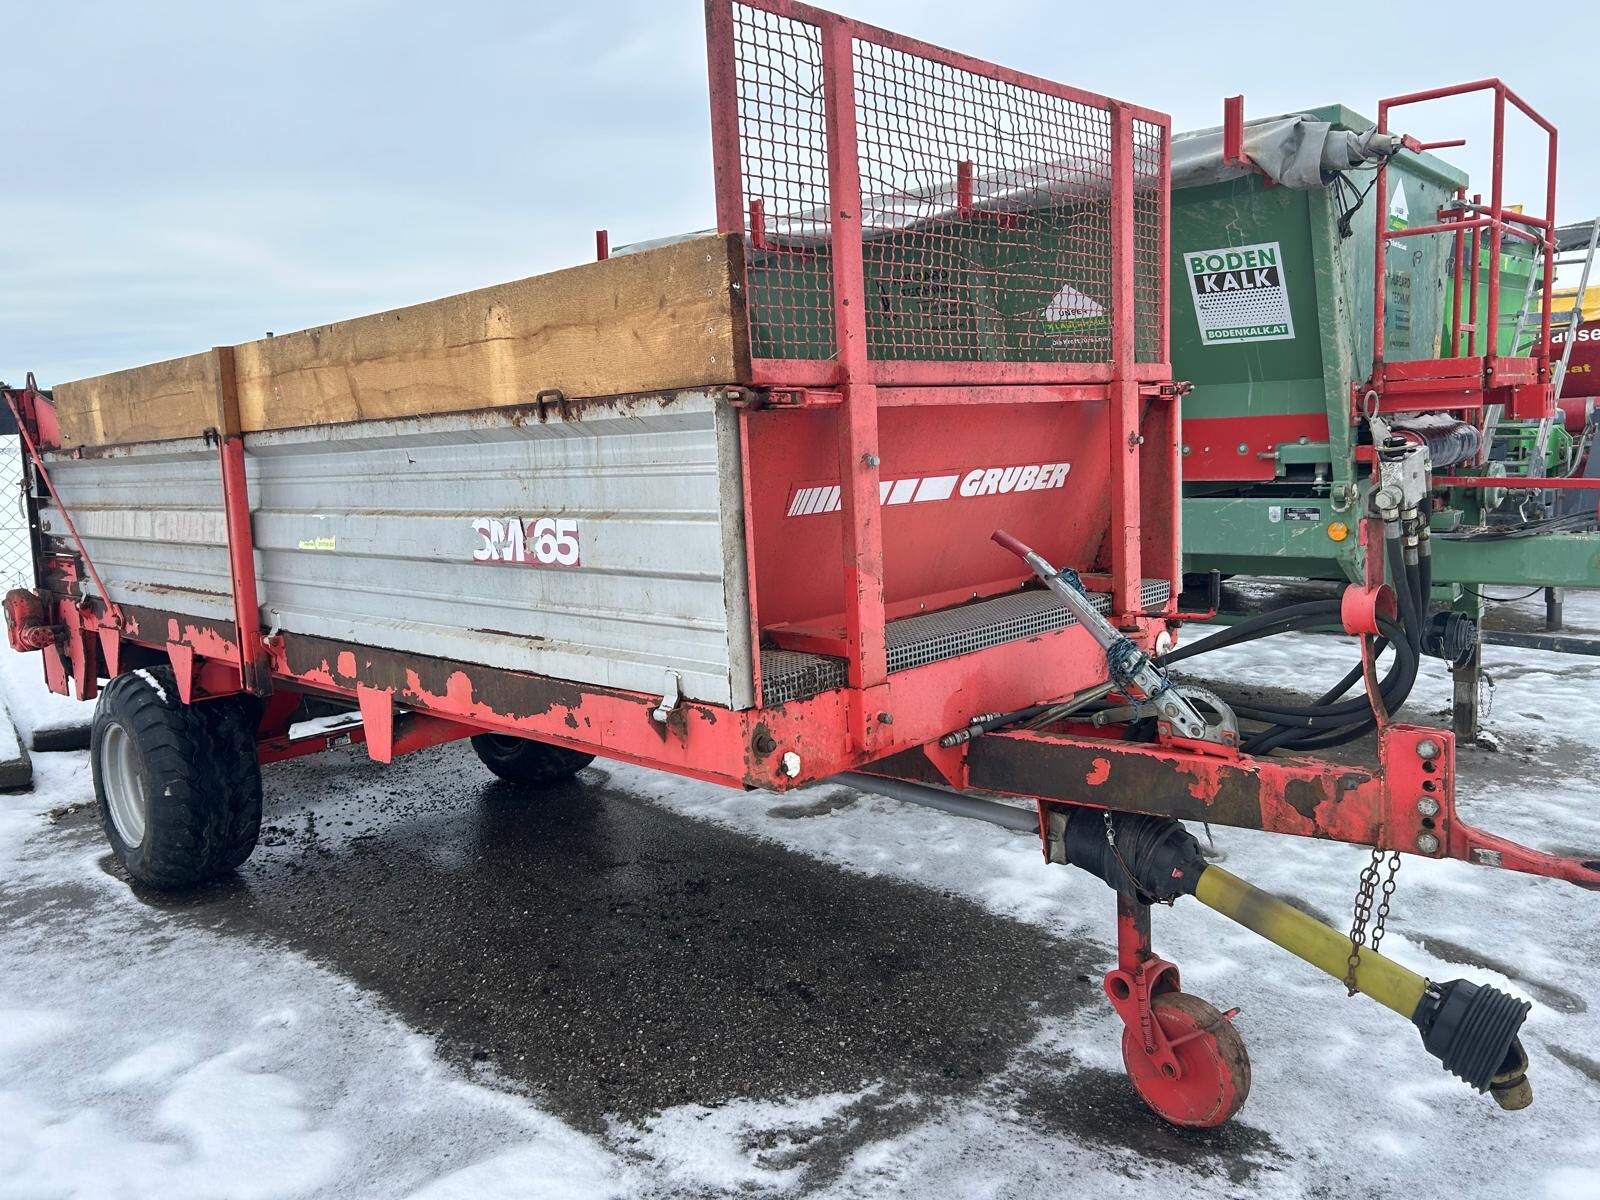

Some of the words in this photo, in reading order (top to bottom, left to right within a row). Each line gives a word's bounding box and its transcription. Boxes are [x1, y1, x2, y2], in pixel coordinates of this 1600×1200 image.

[1190, 246, 1276, 274] BODEN
[1202, 267, 1273, 293] KALK
[1207, 324, 1287, 339] BODENKALK.AT
[959, 463, 1070, 497] GRUBER
[533, 517, 579, 565] 65
